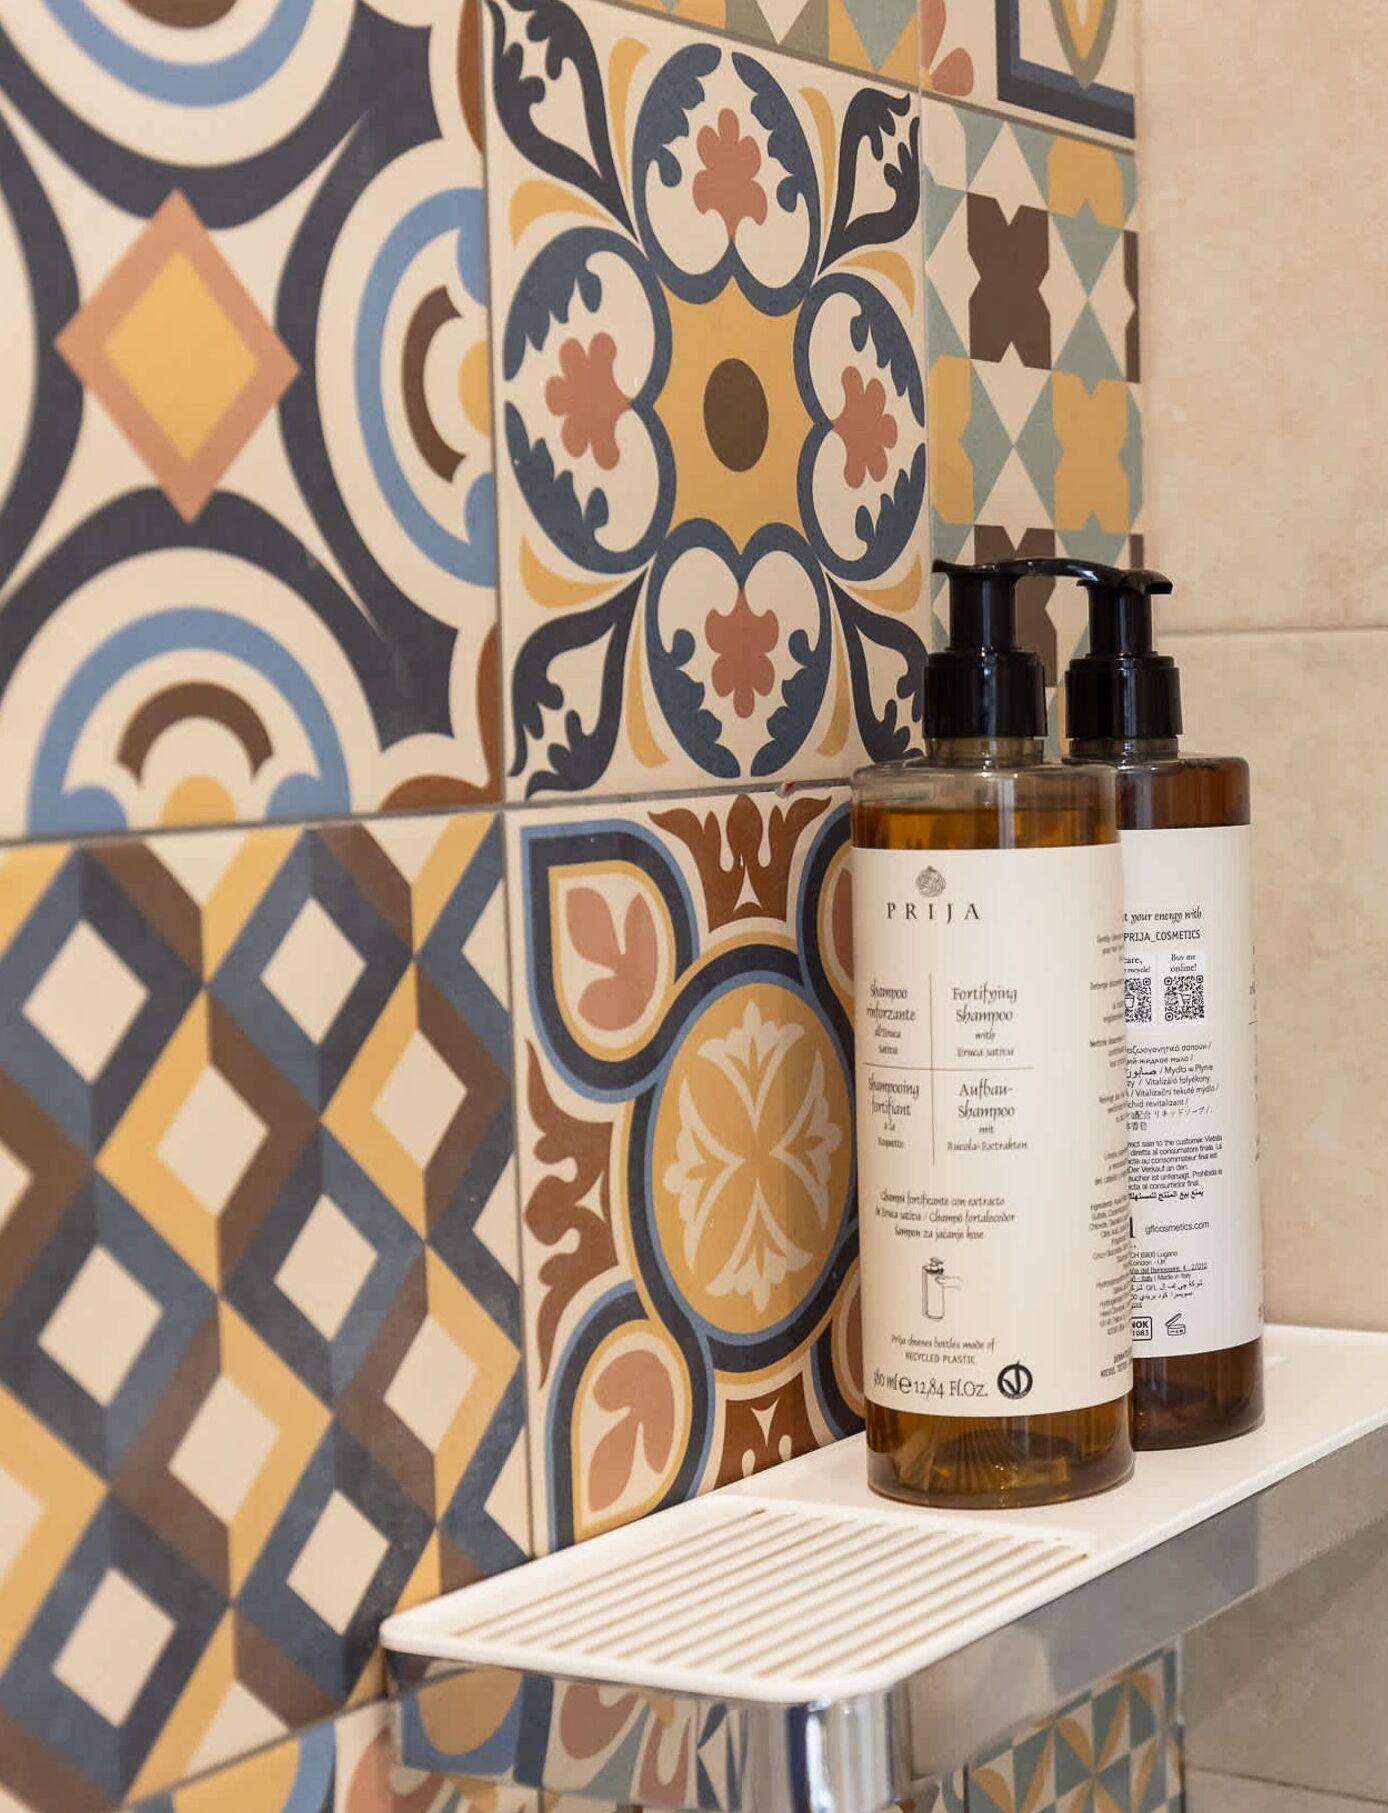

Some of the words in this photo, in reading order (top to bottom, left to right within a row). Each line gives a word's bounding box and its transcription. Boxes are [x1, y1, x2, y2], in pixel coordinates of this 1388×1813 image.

[886, 902, 980, 924] PRIJA
[1131, 912, 1152, 925] your
[1154, 911, 1183, 924] energy
[1185, 906, 1202, 920] with
[1170, 963, 1197, 973] online!
[870, 979, 908, 1002] Shampoo
[952, 981, 1018, 1005] Fortifying
[866, 1001, 916, 1023] rinforzante
[956, 1003, 1014, 1027] Shampoo
[975, 1028, 995, 1041] with
[957, 1047, 984, 1058] Eruca
[986, 1047, 1014, 1058] sativa
[868, 1072, 919, 1099] Shampooing
[959, 1079, 1014, 1101] Aufbau-
[871, 1094, 911, 1119] fortifiant
[958, 1100, 1016, 1121] Shampoo
[979, 1124, 994, 1134] mit
[947, 1137, 1028, 1151] Rucola-Extrakten
[907, 1190, 949, 1209] fortificante
[951, 1197, 966, 1206] con
[967, 1196, 1005, 1206] extracto
[965, 1209, 1016, 1226] fortalecedor
[923, 1229, 933, 1239] za
[905, 1351, 939, 1363] RECYCLED
[942, 1354, 976, 1365] PLASTIC
[914, 1378, 944, 1399] 12,84
